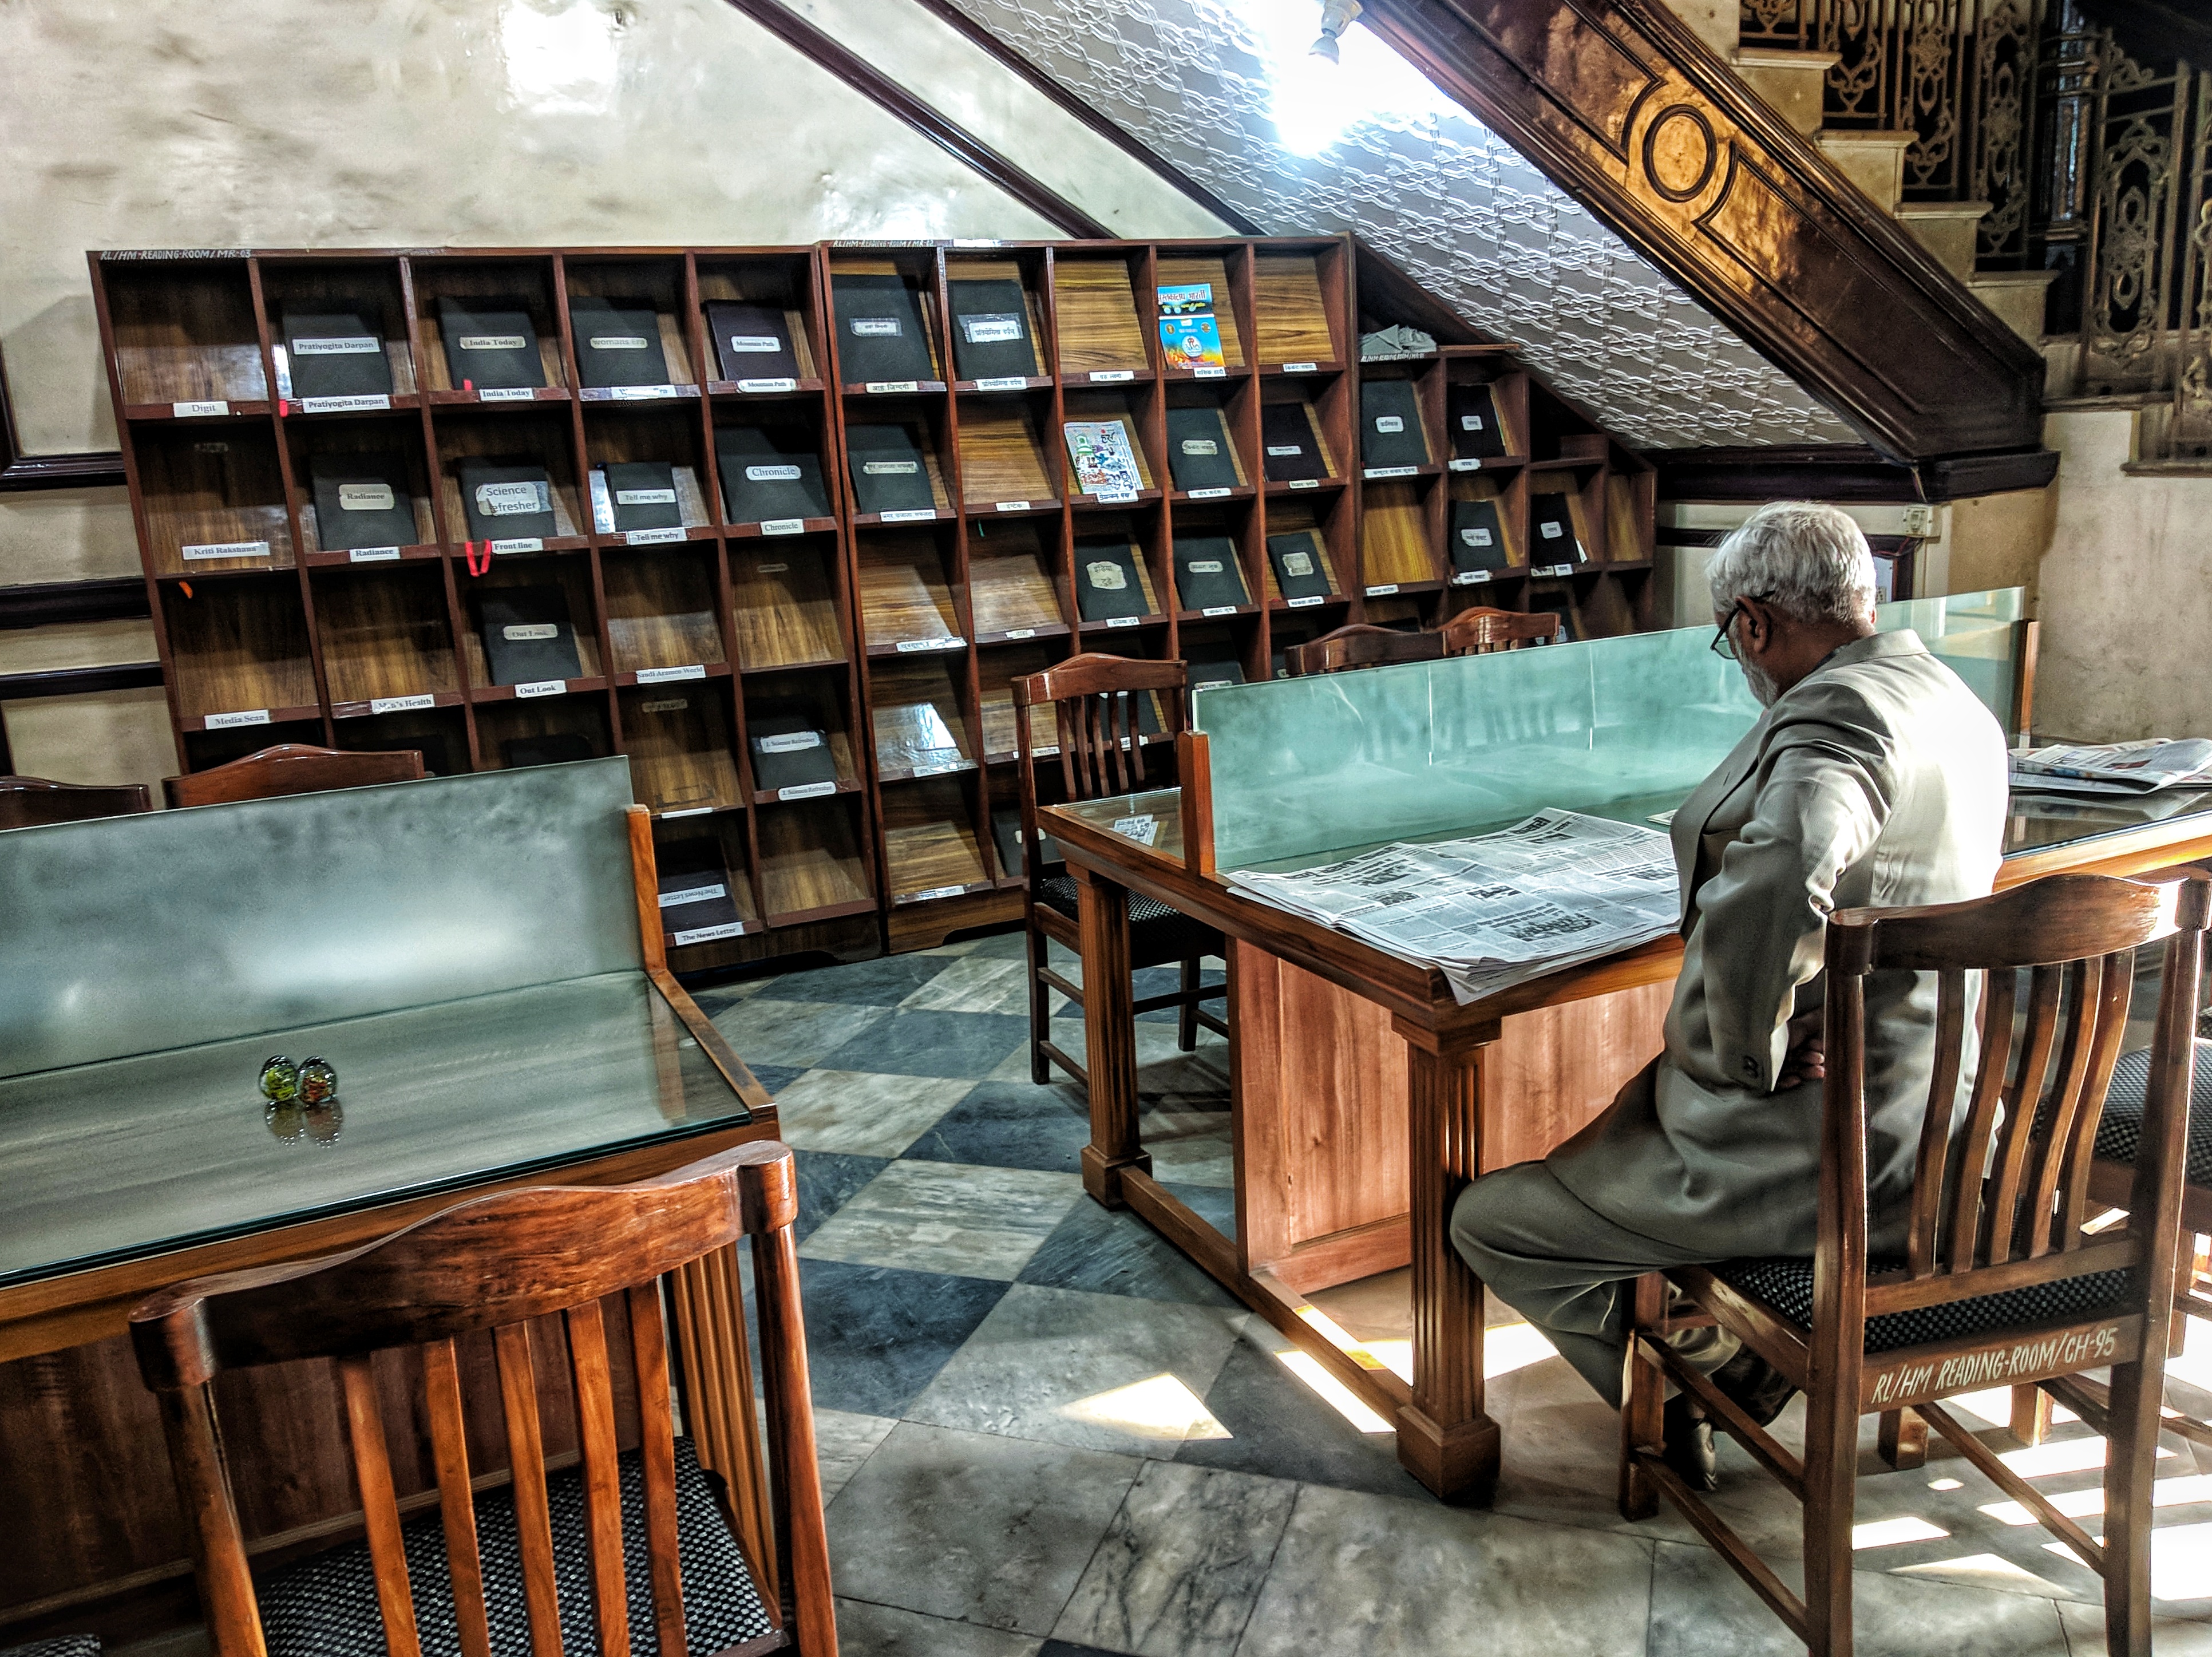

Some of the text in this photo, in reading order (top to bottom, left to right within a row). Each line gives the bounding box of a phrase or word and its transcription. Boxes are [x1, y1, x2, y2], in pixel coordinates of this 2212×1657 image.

[299, 342, 343, 350] Pratiyogita
[506, 389, 531, 397] Today
[192, 404, 216, 413] Digit
[308, 400, 353, 408] Pratiyogita
[751, 467, 796, 476] Chronicle
[486, 487, 527, 496] Science
[489, 501, 536, 513] efresher
[765, 523, 798, 532] Chronicle
[194, 547, 214, 555] Kriti
[355, 548, 394, 557] Radiance
[405, 698, 432, 707] Health
[214, 713, 265, 726] Media Scan
[716, 927, 737, 936] Letter
[1871, 1364, 1934, 1405] RL/HM
